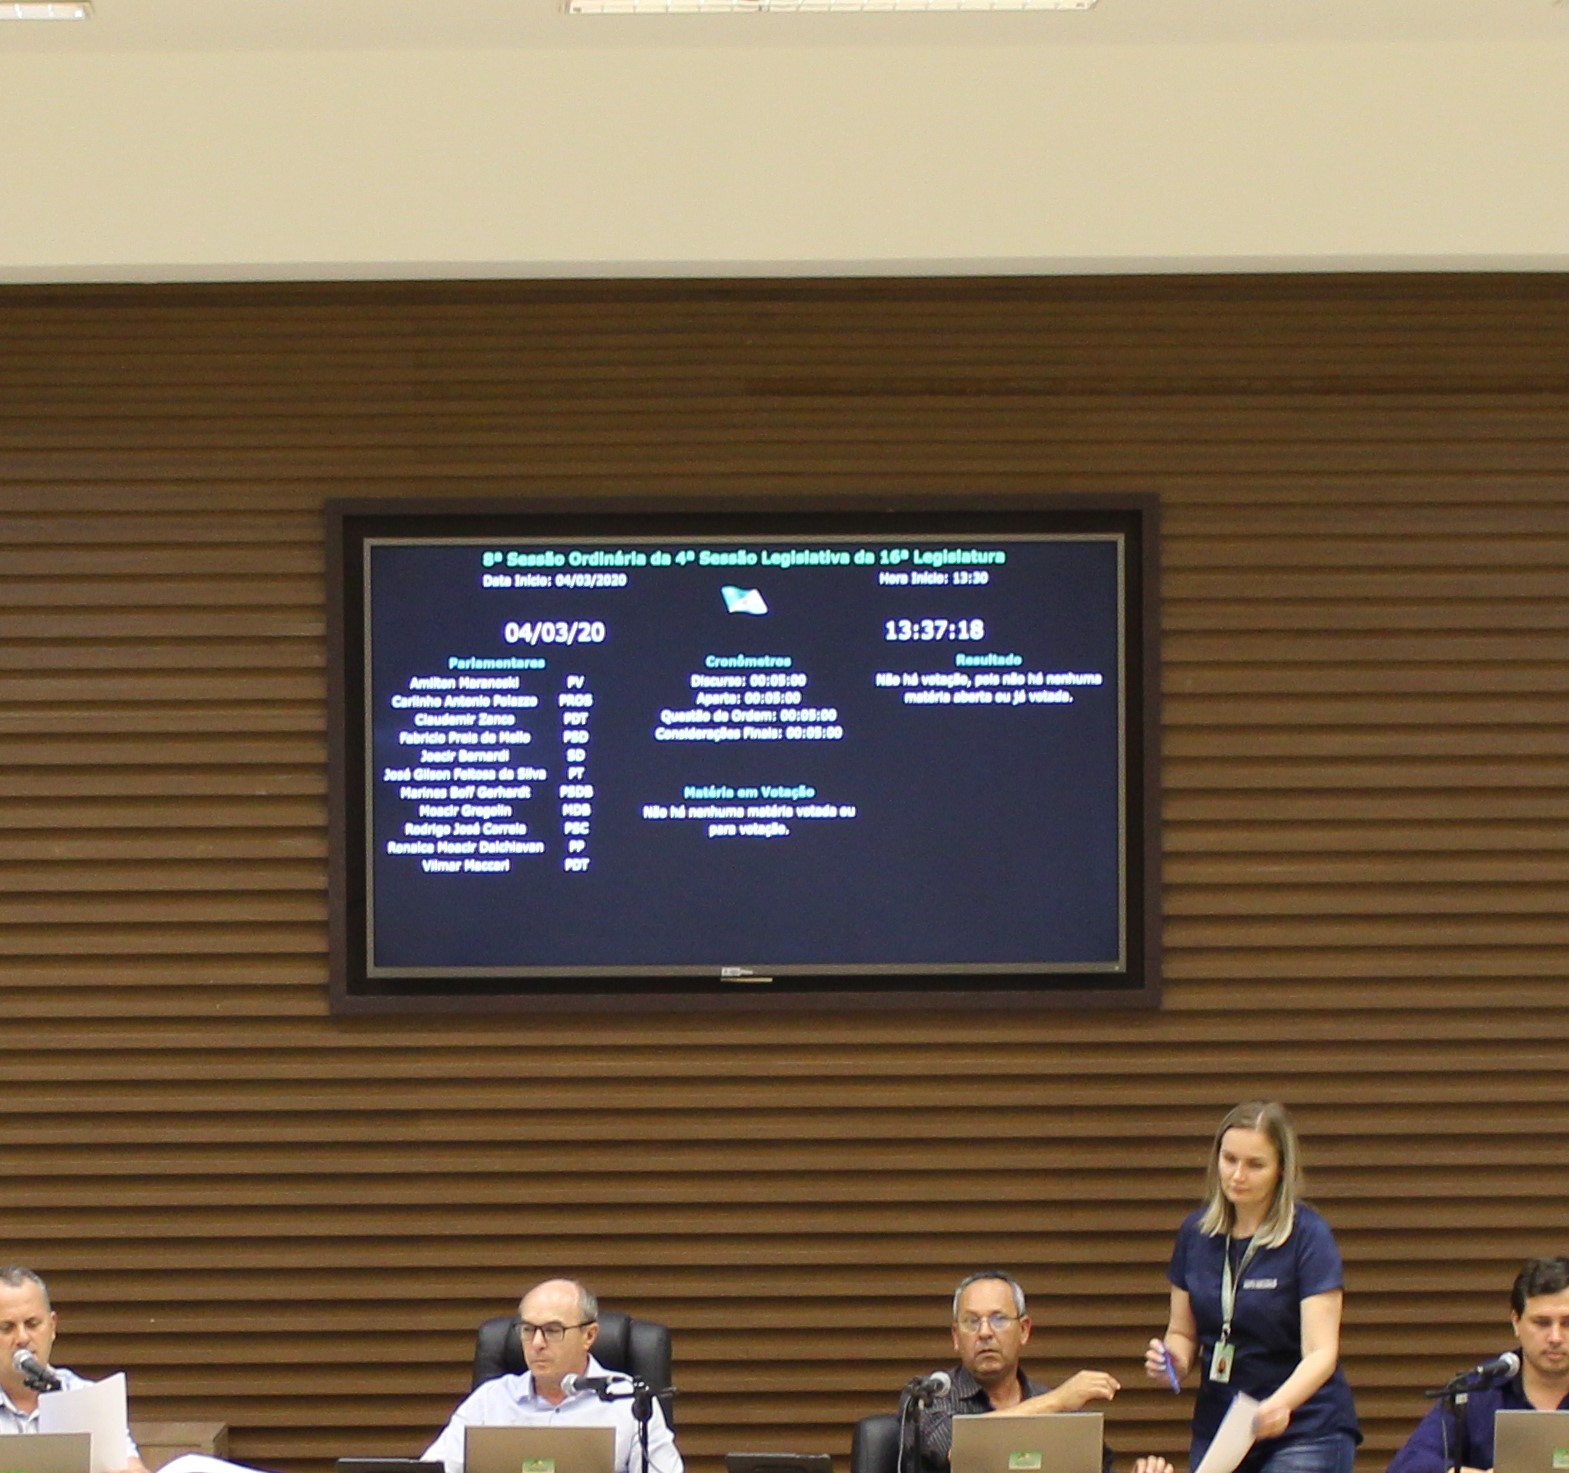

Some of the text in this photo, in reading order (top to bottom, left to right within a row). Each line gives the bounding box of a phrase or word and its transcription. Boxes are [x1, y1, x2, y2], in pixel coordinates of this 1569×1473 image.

[507, 551, 565, 566] Sessão
[569, 550, 646, 566] Ordinária
[650, 551, 671, 565] da
[700, 550, 757, 565] Sessão
[762, 550, 850, 568] Legislativa
[854, 550, 875, 564] da
[914, 549, 1005, 567] Legislatura
[483, 575, 511, 587] Data
[555, 574, 627, 588] 04/03/2020
[880, 572, 908, 584] Hora
[953, 571, 988, 584] 13:30
[505, 622, 605, 645] 04/03/20
[886, 619, 984, 640] 13:37:18
[449, 657, 545, 669] Parlamentares
[956, 654, 1022, 666] Resultado
[567, 676, 584, 688] PV
[691, 674, 745, 687] Discurso:
[876, 672, 1102, 688] Não há votação, pois não há nenhuma
[444, 695, 490, 707] Antonio
[696, 692, 740, 707] Aparte:
[904, 690, 1073, 705] matéria aberta ou já votada.
[564, 712, 588, 725] PDT
[661, 709, 711, 725] Questão
[713, 709, 729, 722] de
[731, 709, 776, 722] Ordem:
[480, 731, 496, 744] de
[563, 730, 589, 743] PSD
[655, 727, 741, 742] Considerações
[743, 727, 782, 739] Finais:
[458, 749, 509, 762] Bernardi
[567, 749, 585, 762] SD
[384, 767, 546, 781] José Gilson Feitosa da Silva
[568, 767, 584, 779] PT
[560, 785, 593, 798] PSDB
[684, 785, 815, 800] Matéria em Votação
[420, 805, 459, 817] Moacir
[562, 803, 591, 816] MDB
[643, 804, 855, 818] Não há nenhuma matéria votada ou
[405, 823, 451, 838] Rodrigo
[453, 822, 480, 835] José
[564, 822, 589, 834] PSC
[709, 822, 789, 837] para votação.
[437, 841, 477, 853] Moacir
[569, 840, 585, 852] PP
[422, 859, 509, 872] Vilmar Maccari
[565, 858, 589, 871] PDT
